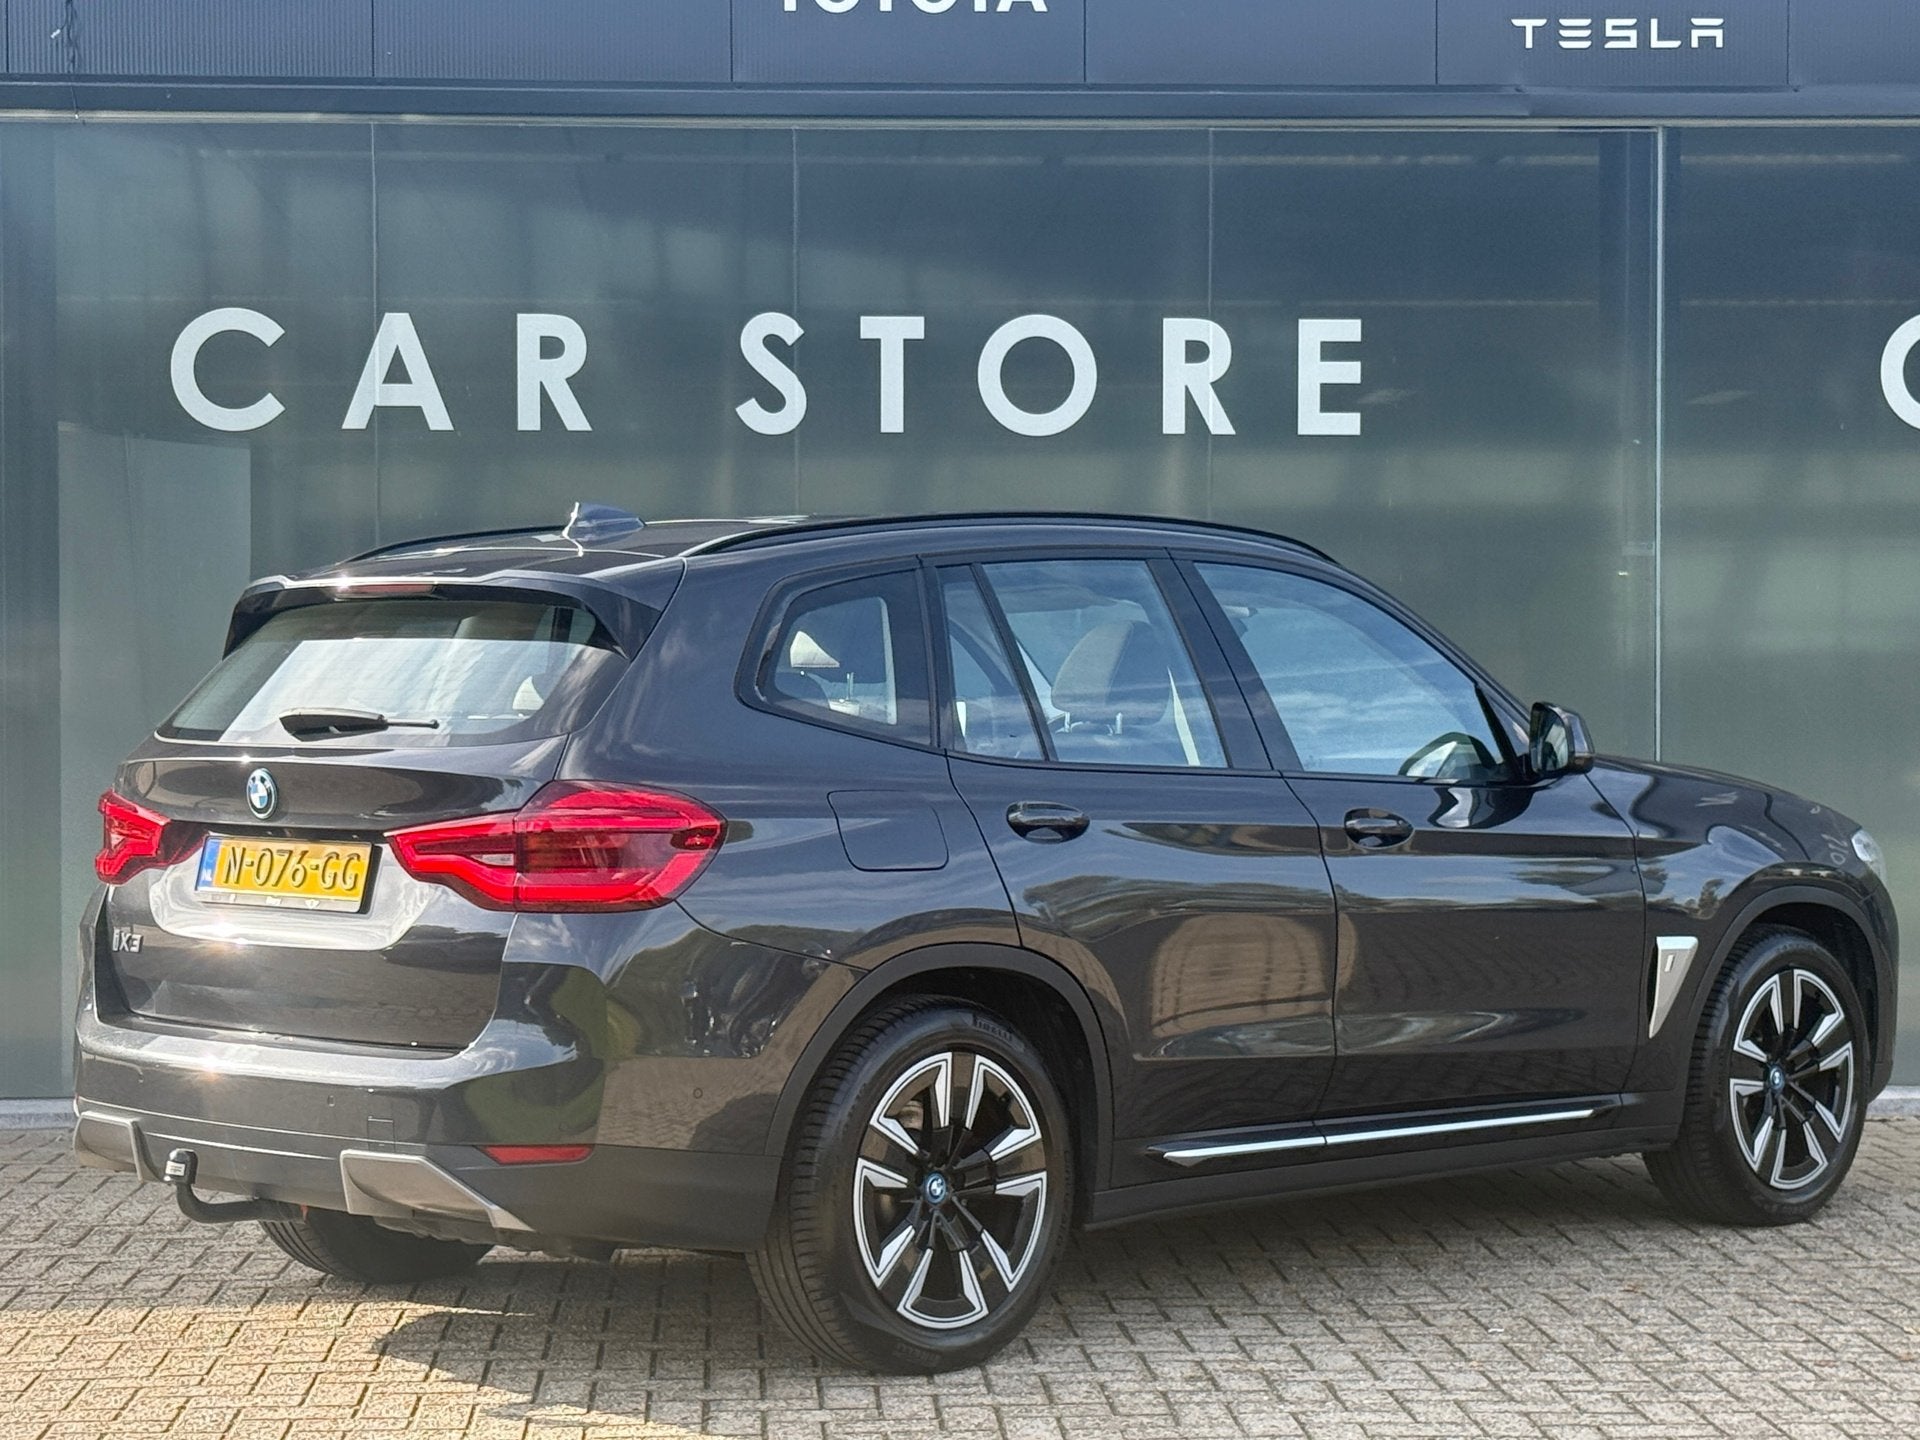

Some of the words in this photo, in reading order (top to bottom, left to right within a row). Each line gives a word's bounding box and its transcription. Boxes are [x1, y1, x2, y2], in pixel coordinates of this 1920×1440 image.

[1512, 18, 1723, 49] TESLA
[170, 307, 592, 432] CAR
[736, 312, 1362, 437] STORE
[223, 846, 361, 891] N-076-GG
